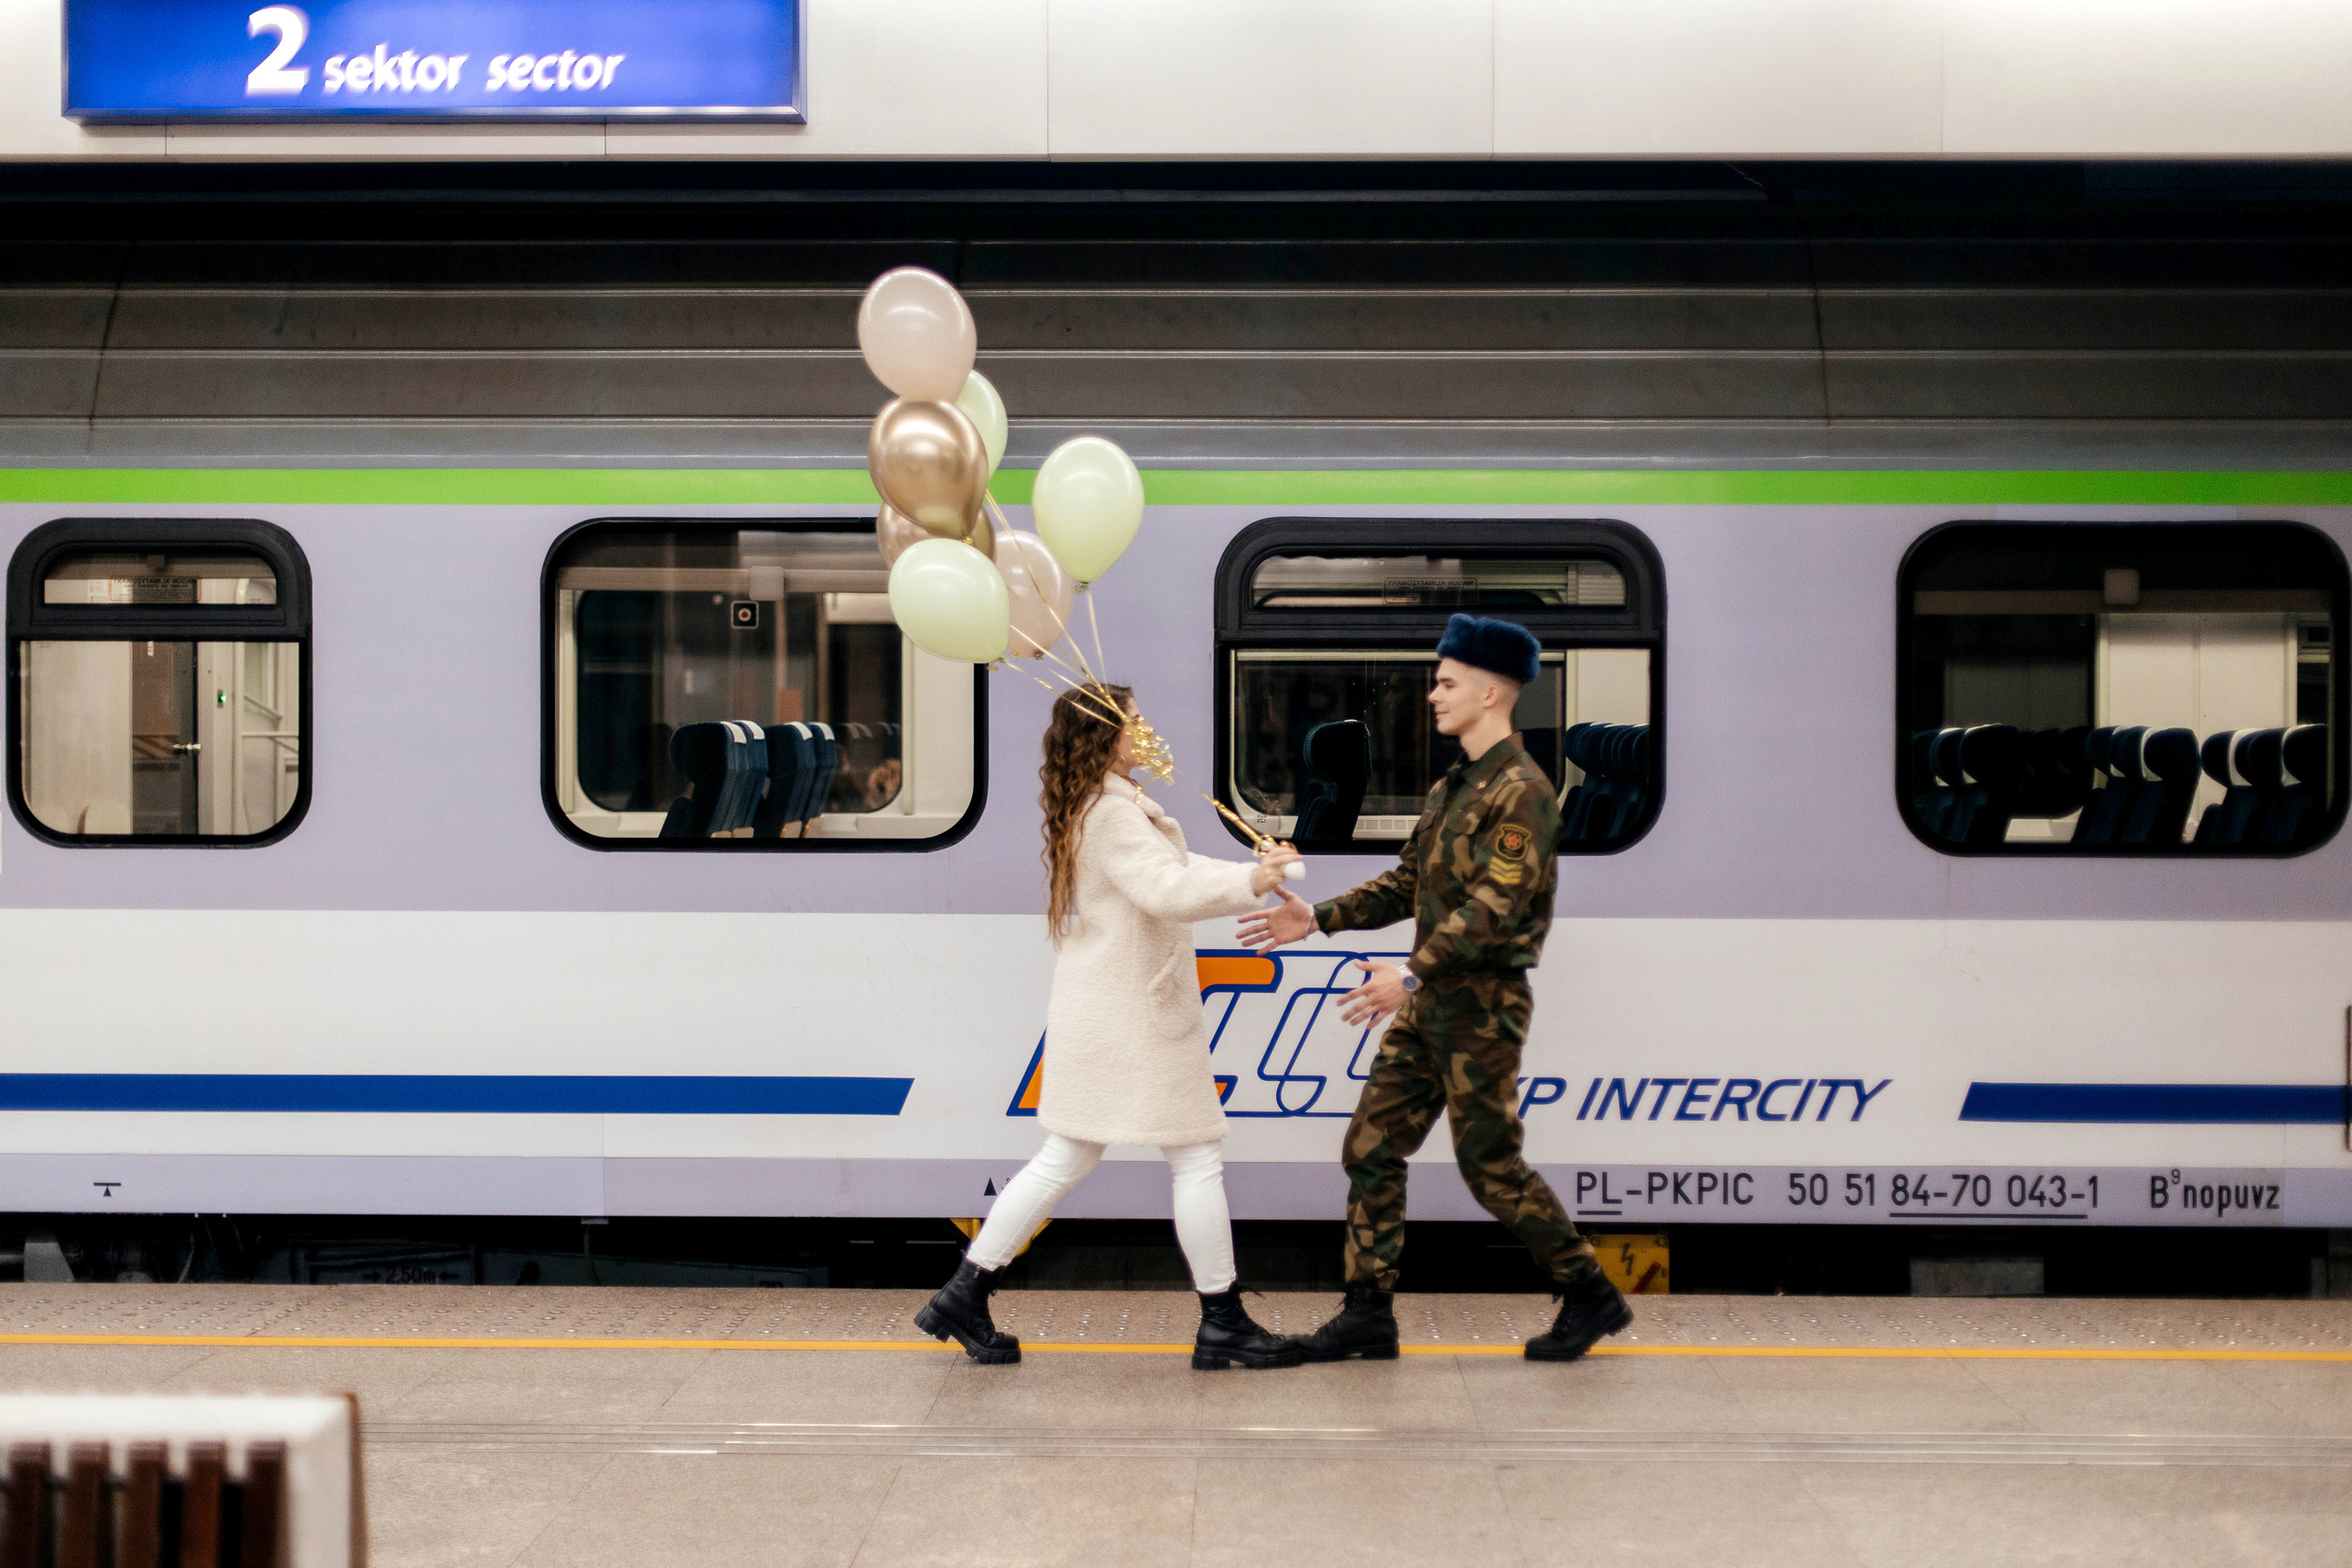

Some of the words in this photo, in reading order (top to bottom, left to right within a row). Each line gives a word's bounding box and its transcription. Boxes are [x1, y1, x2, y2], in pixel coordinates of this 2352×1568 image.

[246, 6, 308, 94] 2
[323, 43, 469, 93] sektor
[484, 50, 626, 92] sector
[1517, 1077, 1567, 1121] P
[1576, 1077, 1893, 1122] INTERCITY
[1576, 1171, 1754, 1206] PL-PKPIC
[1788, 1172, 1828, 1206] 50
[1844, 1173, 1875, 1207] 51
[1891, 1173, 1992, 1208] 84-70
[2007, 1174, 2098, 1209] 043-1
